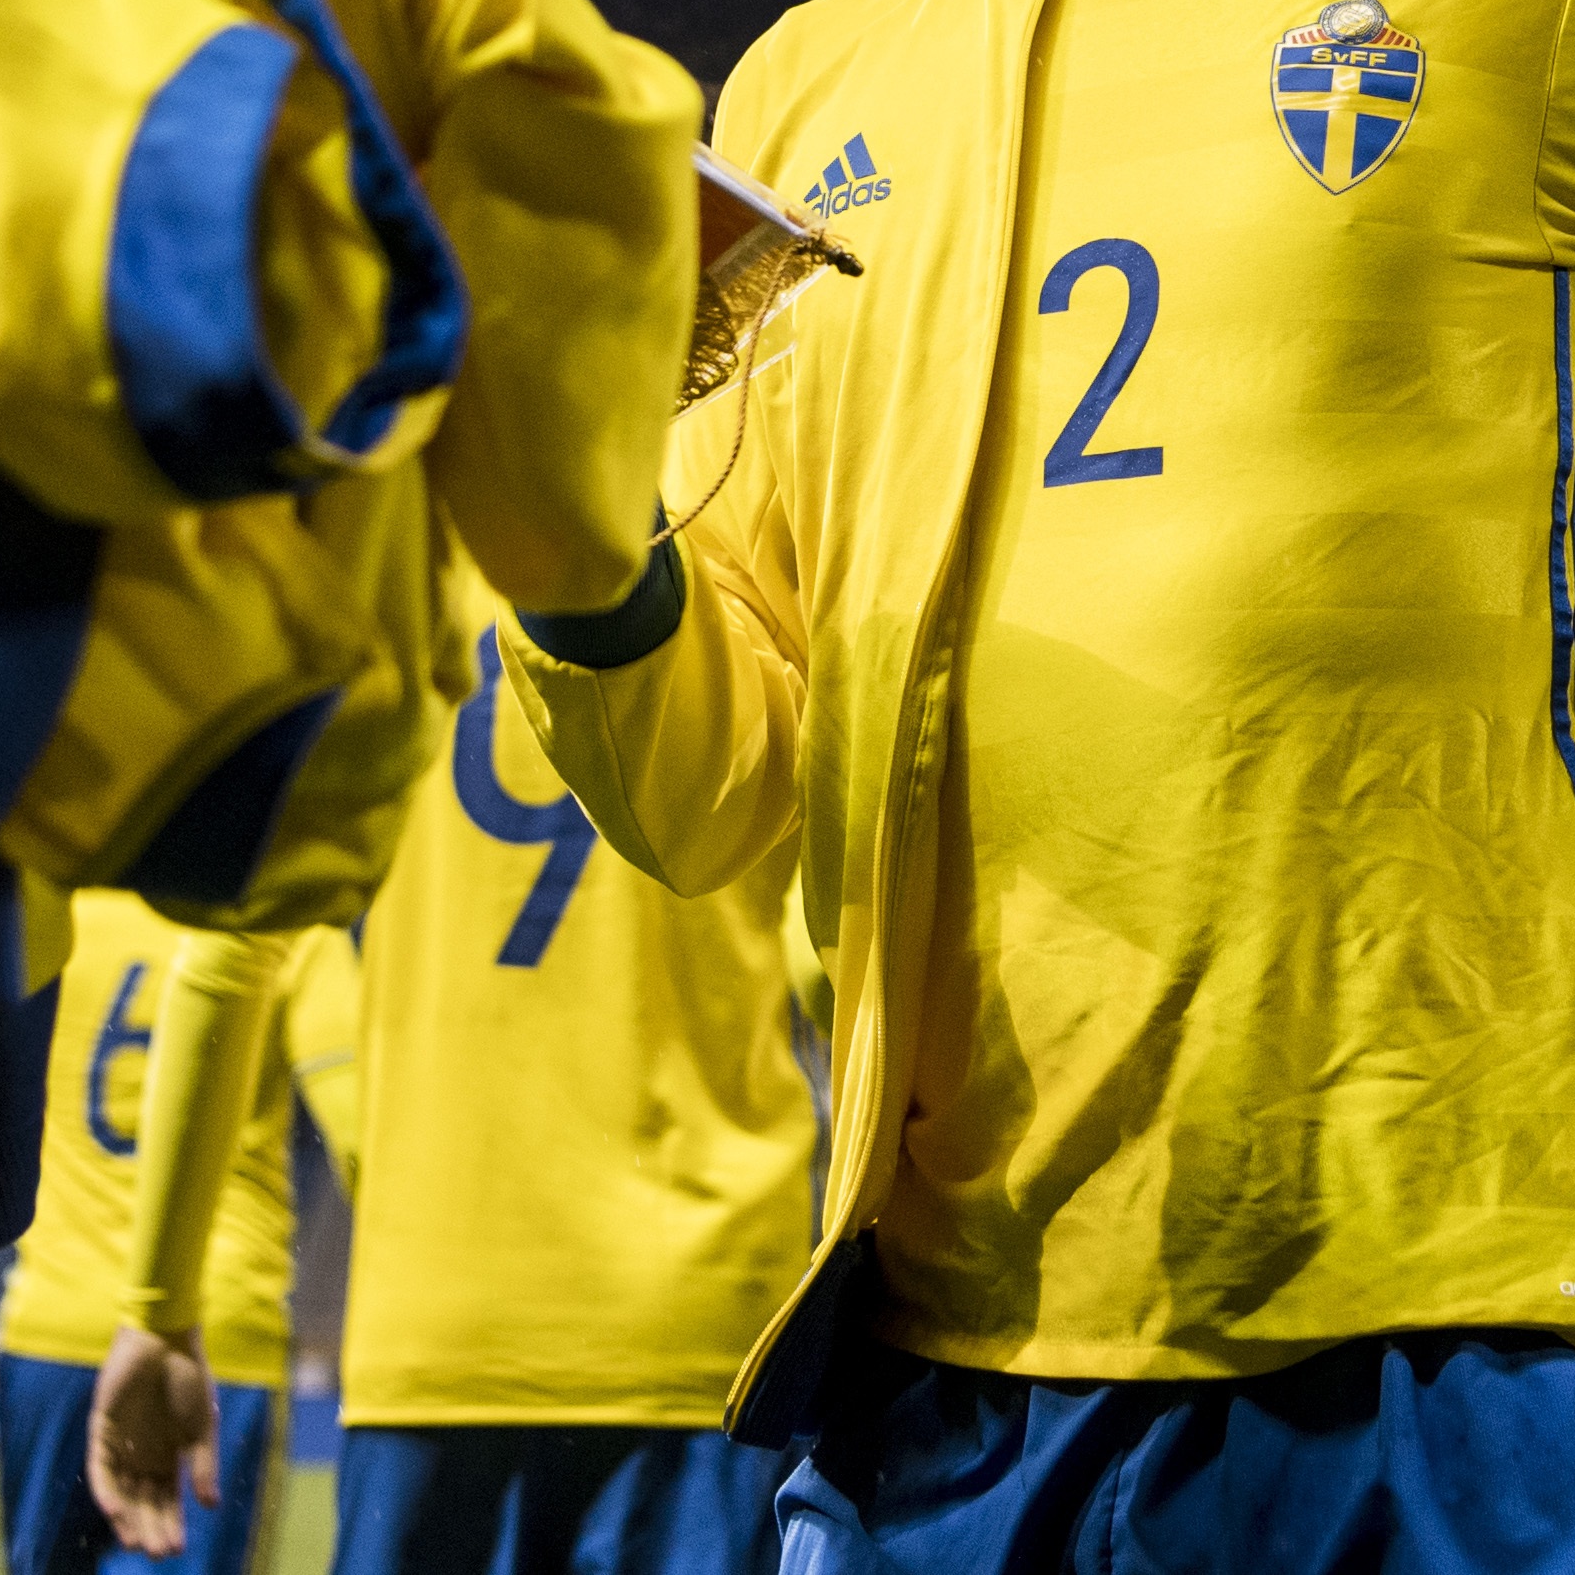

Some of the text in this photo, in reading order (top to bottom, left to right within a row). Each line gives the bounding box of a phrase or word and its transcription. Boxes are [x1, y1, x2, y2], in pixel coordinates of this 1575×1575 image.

[1311, 47, 1387, 67] SvFF
[1037, 238, 1164, 489] 2
[452, 624, 598, 968] 9
